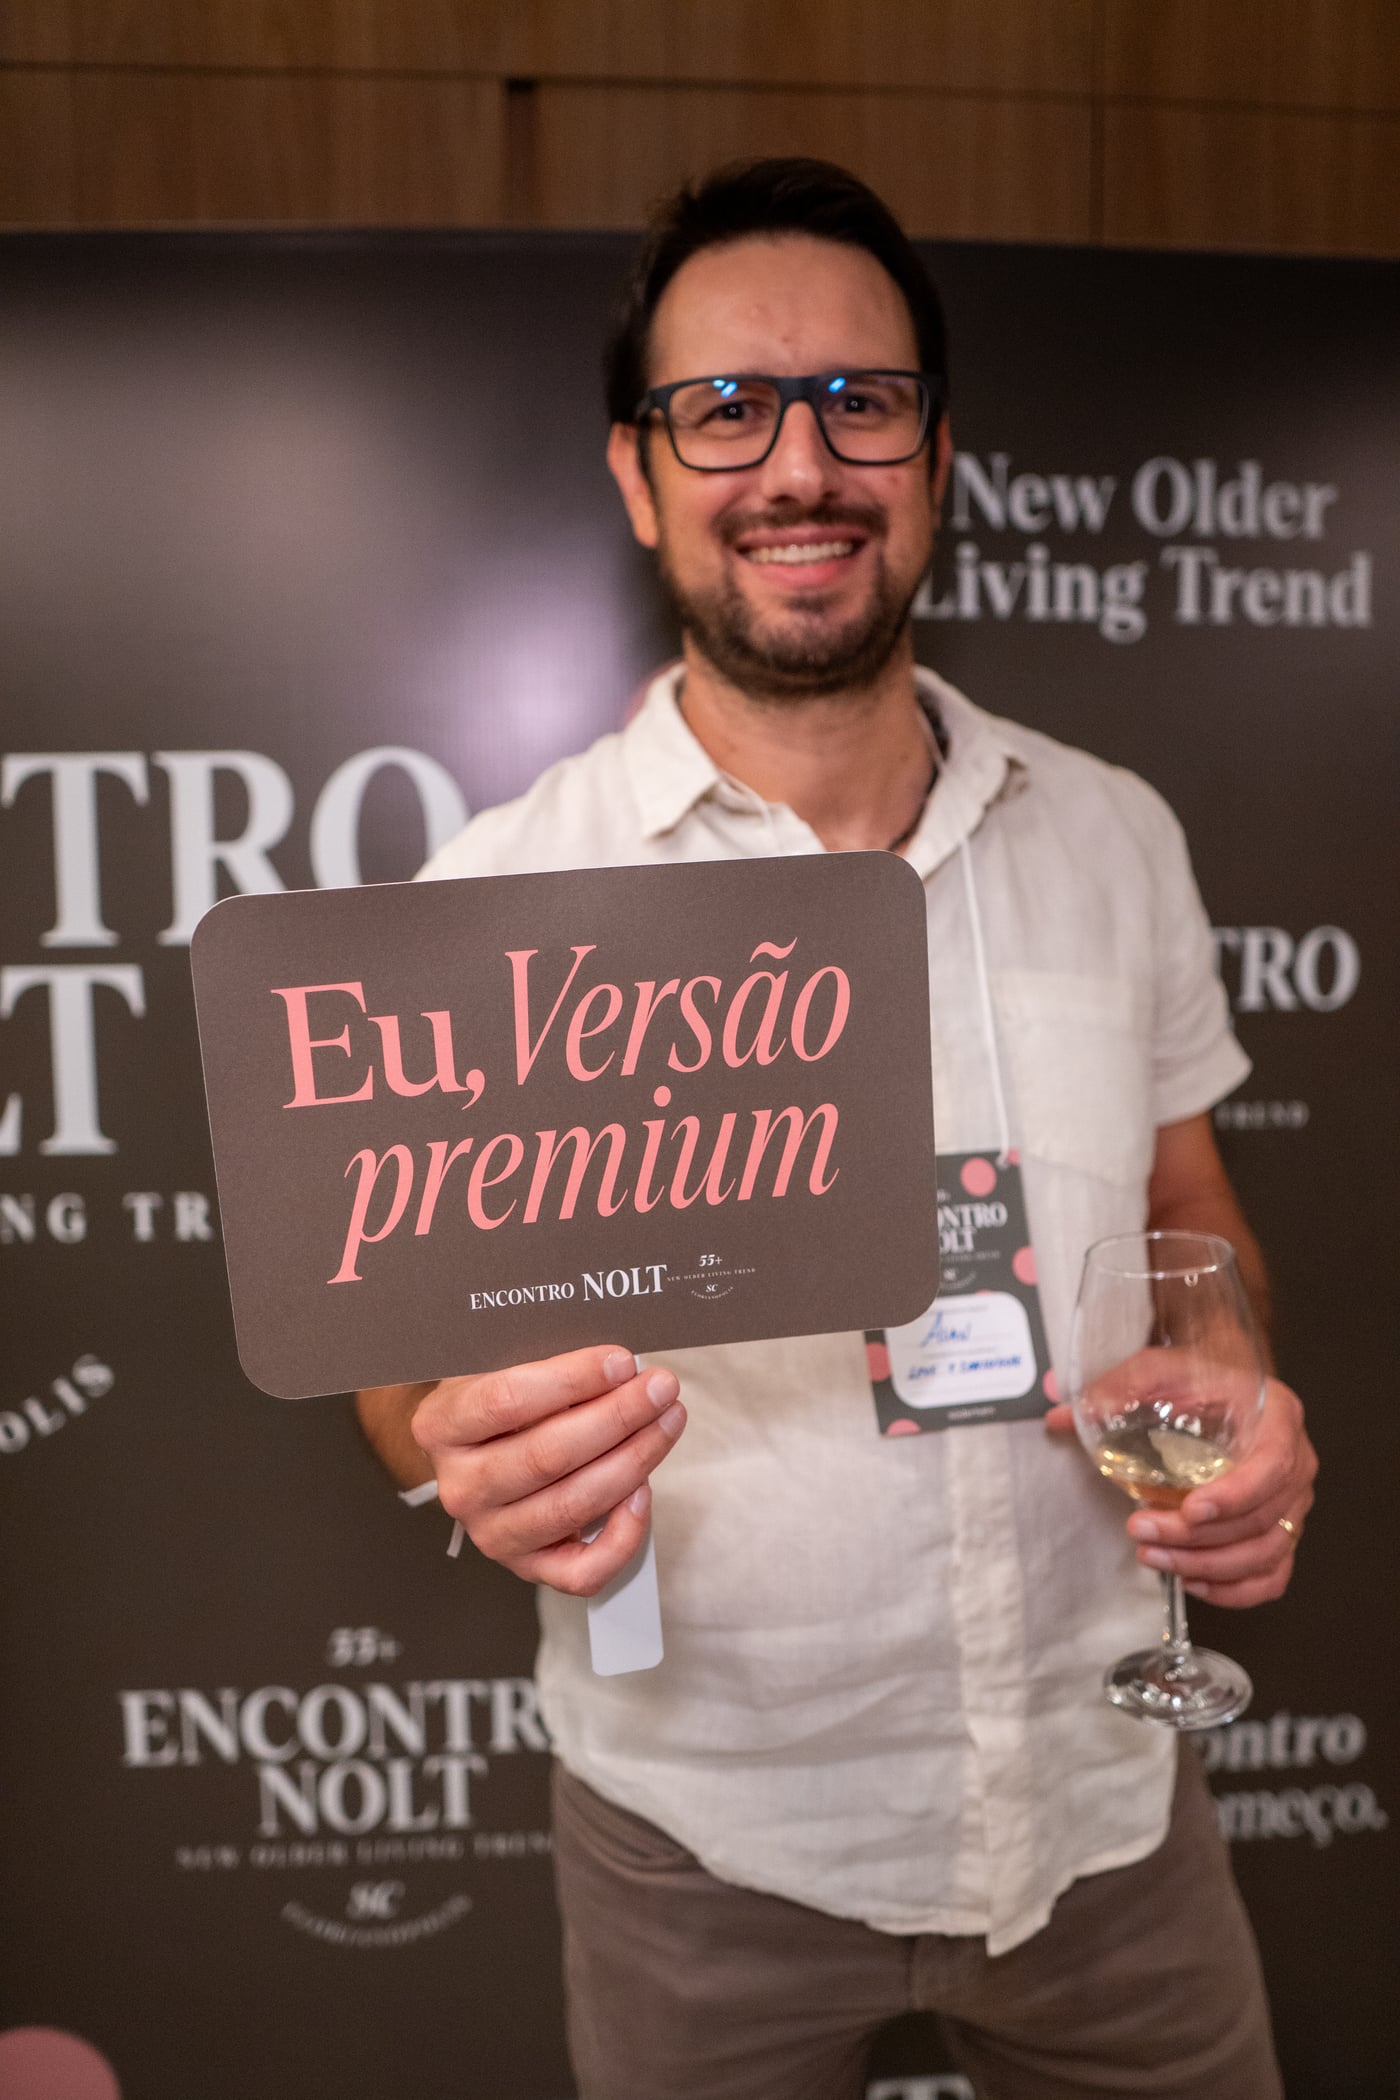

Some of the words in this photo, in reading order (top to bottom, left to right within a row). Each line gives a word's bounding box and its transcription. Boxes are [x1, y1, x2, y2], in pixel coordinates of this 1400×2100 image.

[951, 451, 1117, 532] New
[1131, 456, 1338, 539] Older
[911, 542, 1148, 645] Living
[1159, 546, 1373, 627] Trend
[271, 981, 485, 1110] Eu,
[505, 936, 851, 1086] Versão
[327, 1086, 841, 1284] premium
[470, 1282, 575, 1310] ENCONTRO
[581, 1264, 667, 1301] NOLT
[699, 1254, 723, 1267] 55+
[705, 1283, 719, 1293] SC
[258, 1755, 488, 1837] NOLT
